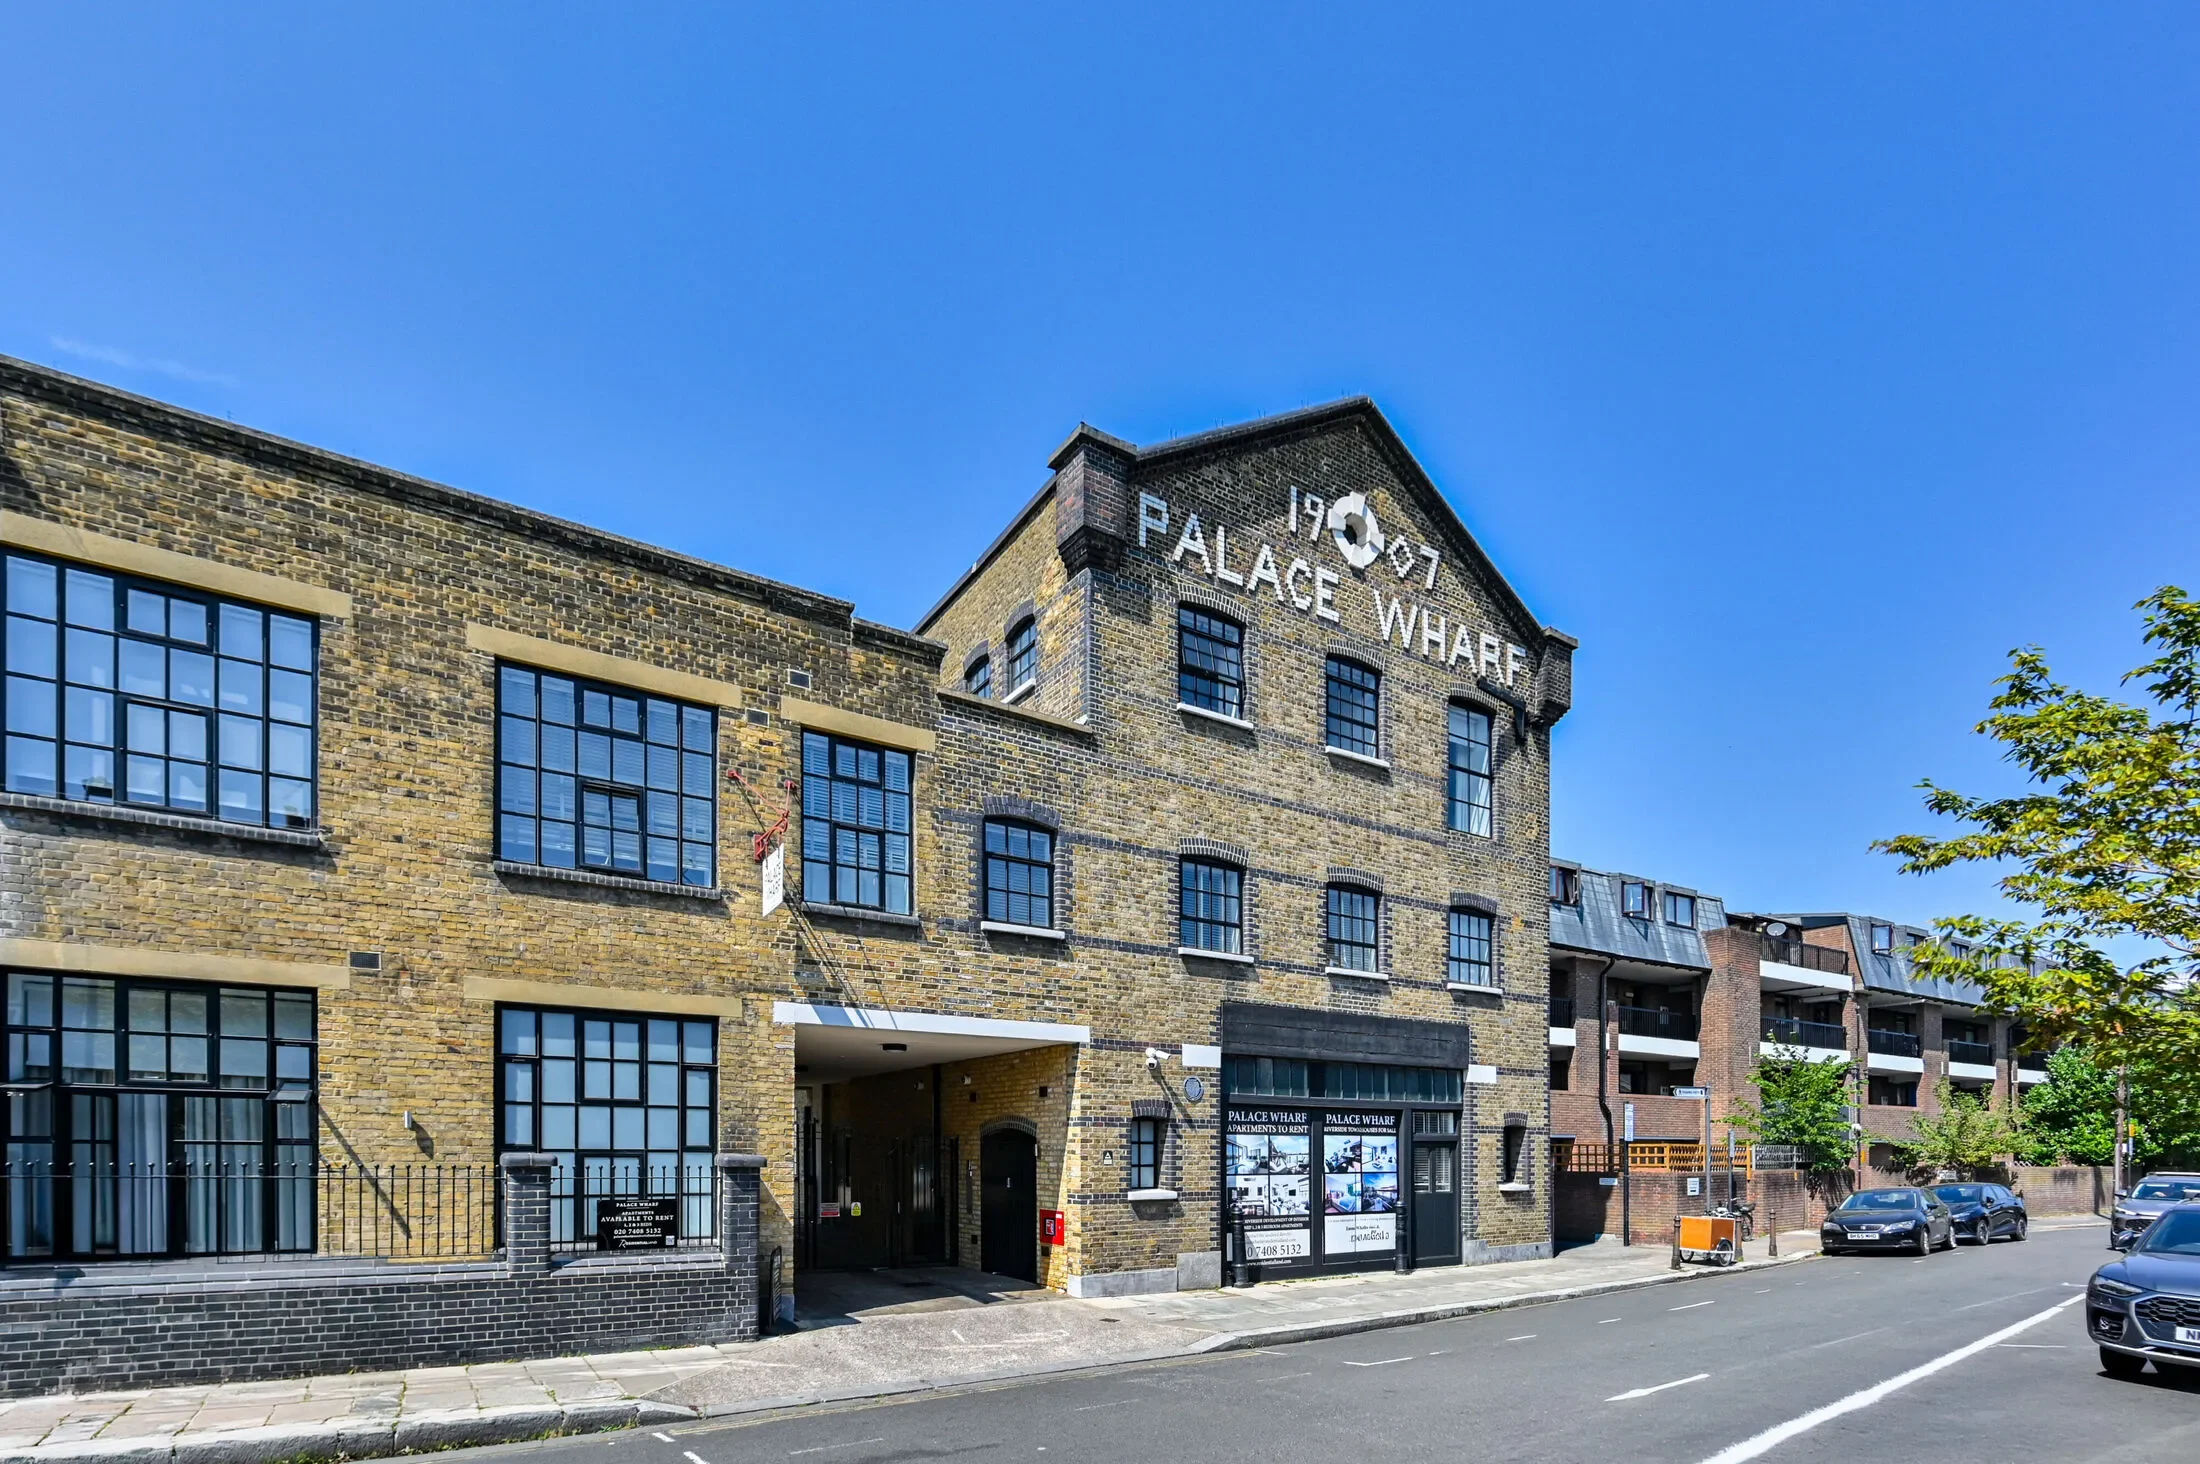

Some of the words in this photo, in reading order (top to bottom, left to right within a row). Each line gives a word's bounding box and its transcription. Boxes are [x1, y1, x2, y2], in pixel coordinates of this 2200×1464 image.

[1138, 491, 1340, 624] PALACE
[1373, 588, 1526, 688] WHARF
[1228, 1110, 1268, 1122] PALACE
[1270, 1111, 1308, 1123] WHARF
[1326, 1113, 1360, 1125] PALACE
[1362, 1114, 1396, 1126] WHARF
[1226, 1124, 1276, 1133] APARTMENTS
[1277, 1125, 1288, 1133] TO
[1289, 1125, 1309, 1134] RENT
[1256, 1245, 1278, 1257] 7408
[1280, 1243, 1302, 1256] 5132
